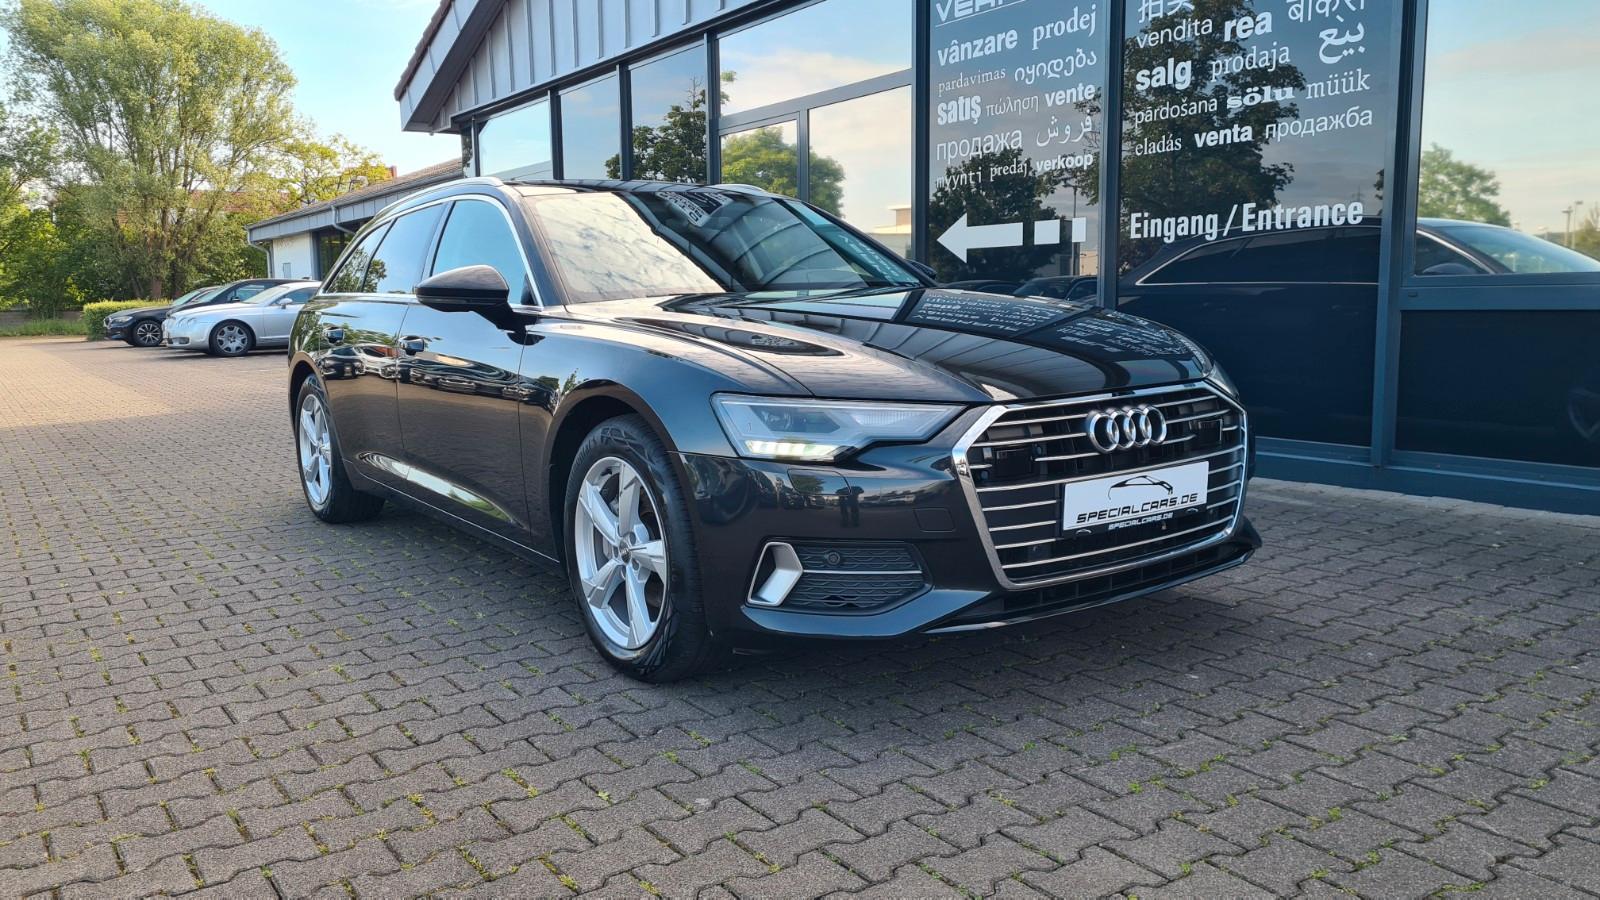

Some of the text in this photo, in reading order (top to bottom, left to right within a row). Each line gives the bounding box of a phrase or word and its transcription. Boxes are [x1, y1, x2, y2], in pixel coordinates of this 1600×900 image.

[937, 4, 1097, 67] vânzare prodej
[1136, 11, 1272, 49] vendita rea
[1319, 22, 1365, 64] بيع
[938, 67, 1006, 97] pardavimas
[1014, 48, 1097, 85] იყიდება
[1135, 41, 1290, 90] salg prodaja
[937, 95, 982, 125] satış
[986, 95, 1039, 117] πώληση
[1045, 83, 1096, 107] vente
[1135, 68, 1371, 129] pārdošana sölu müük
[1036, 109, 1093, 147] فروش
[1135, 123, 1253, 157] eladás venta
[1265, 105, 1373, 142] продажба
[936, 129, 1023, 165] продажа
[936, 153, 1094, 191] myynti predaj verkoop
[1076, 493, 1199, 524] SPECIALCARS.DE
